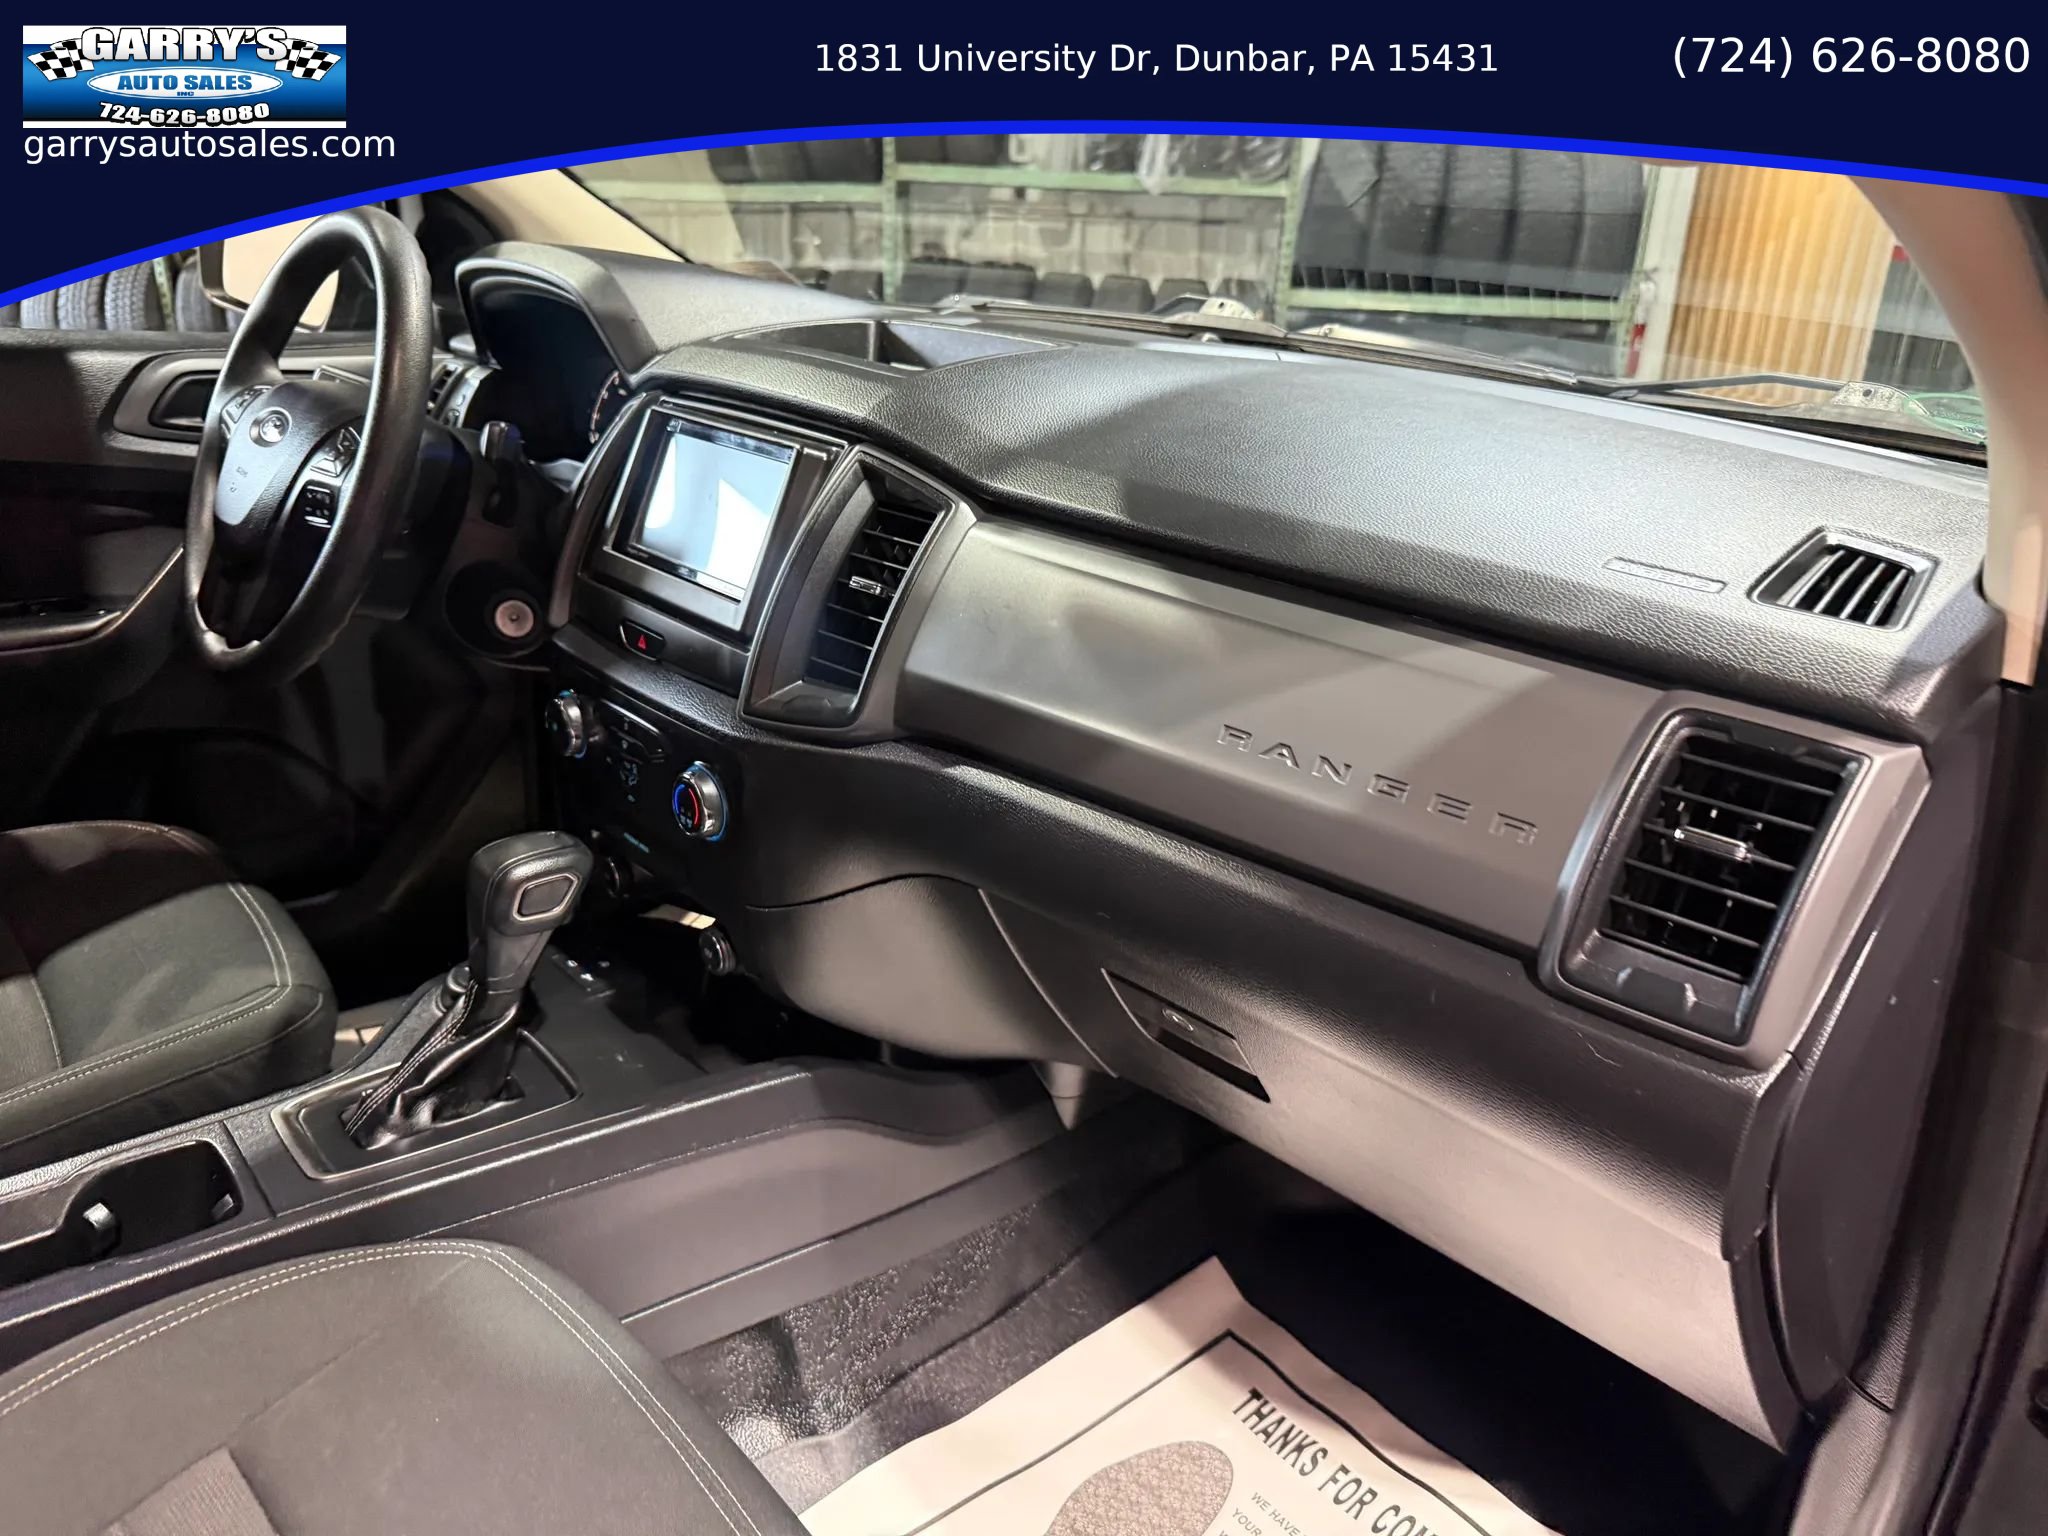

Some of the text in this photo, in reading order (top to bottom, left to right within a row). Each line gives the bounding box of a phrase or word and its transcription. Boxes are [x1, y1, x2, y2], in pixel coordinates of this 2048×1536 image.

[1217, 723, 1538, 846] RANGER
[1232, 1386, 1329, 1477] THANKS
[1317, 1463, 1378, 1521] FOR
[1232, 1507, 1262, 1536] YOUR
[1251, 1491, 1301, 1536] WE HAVE
